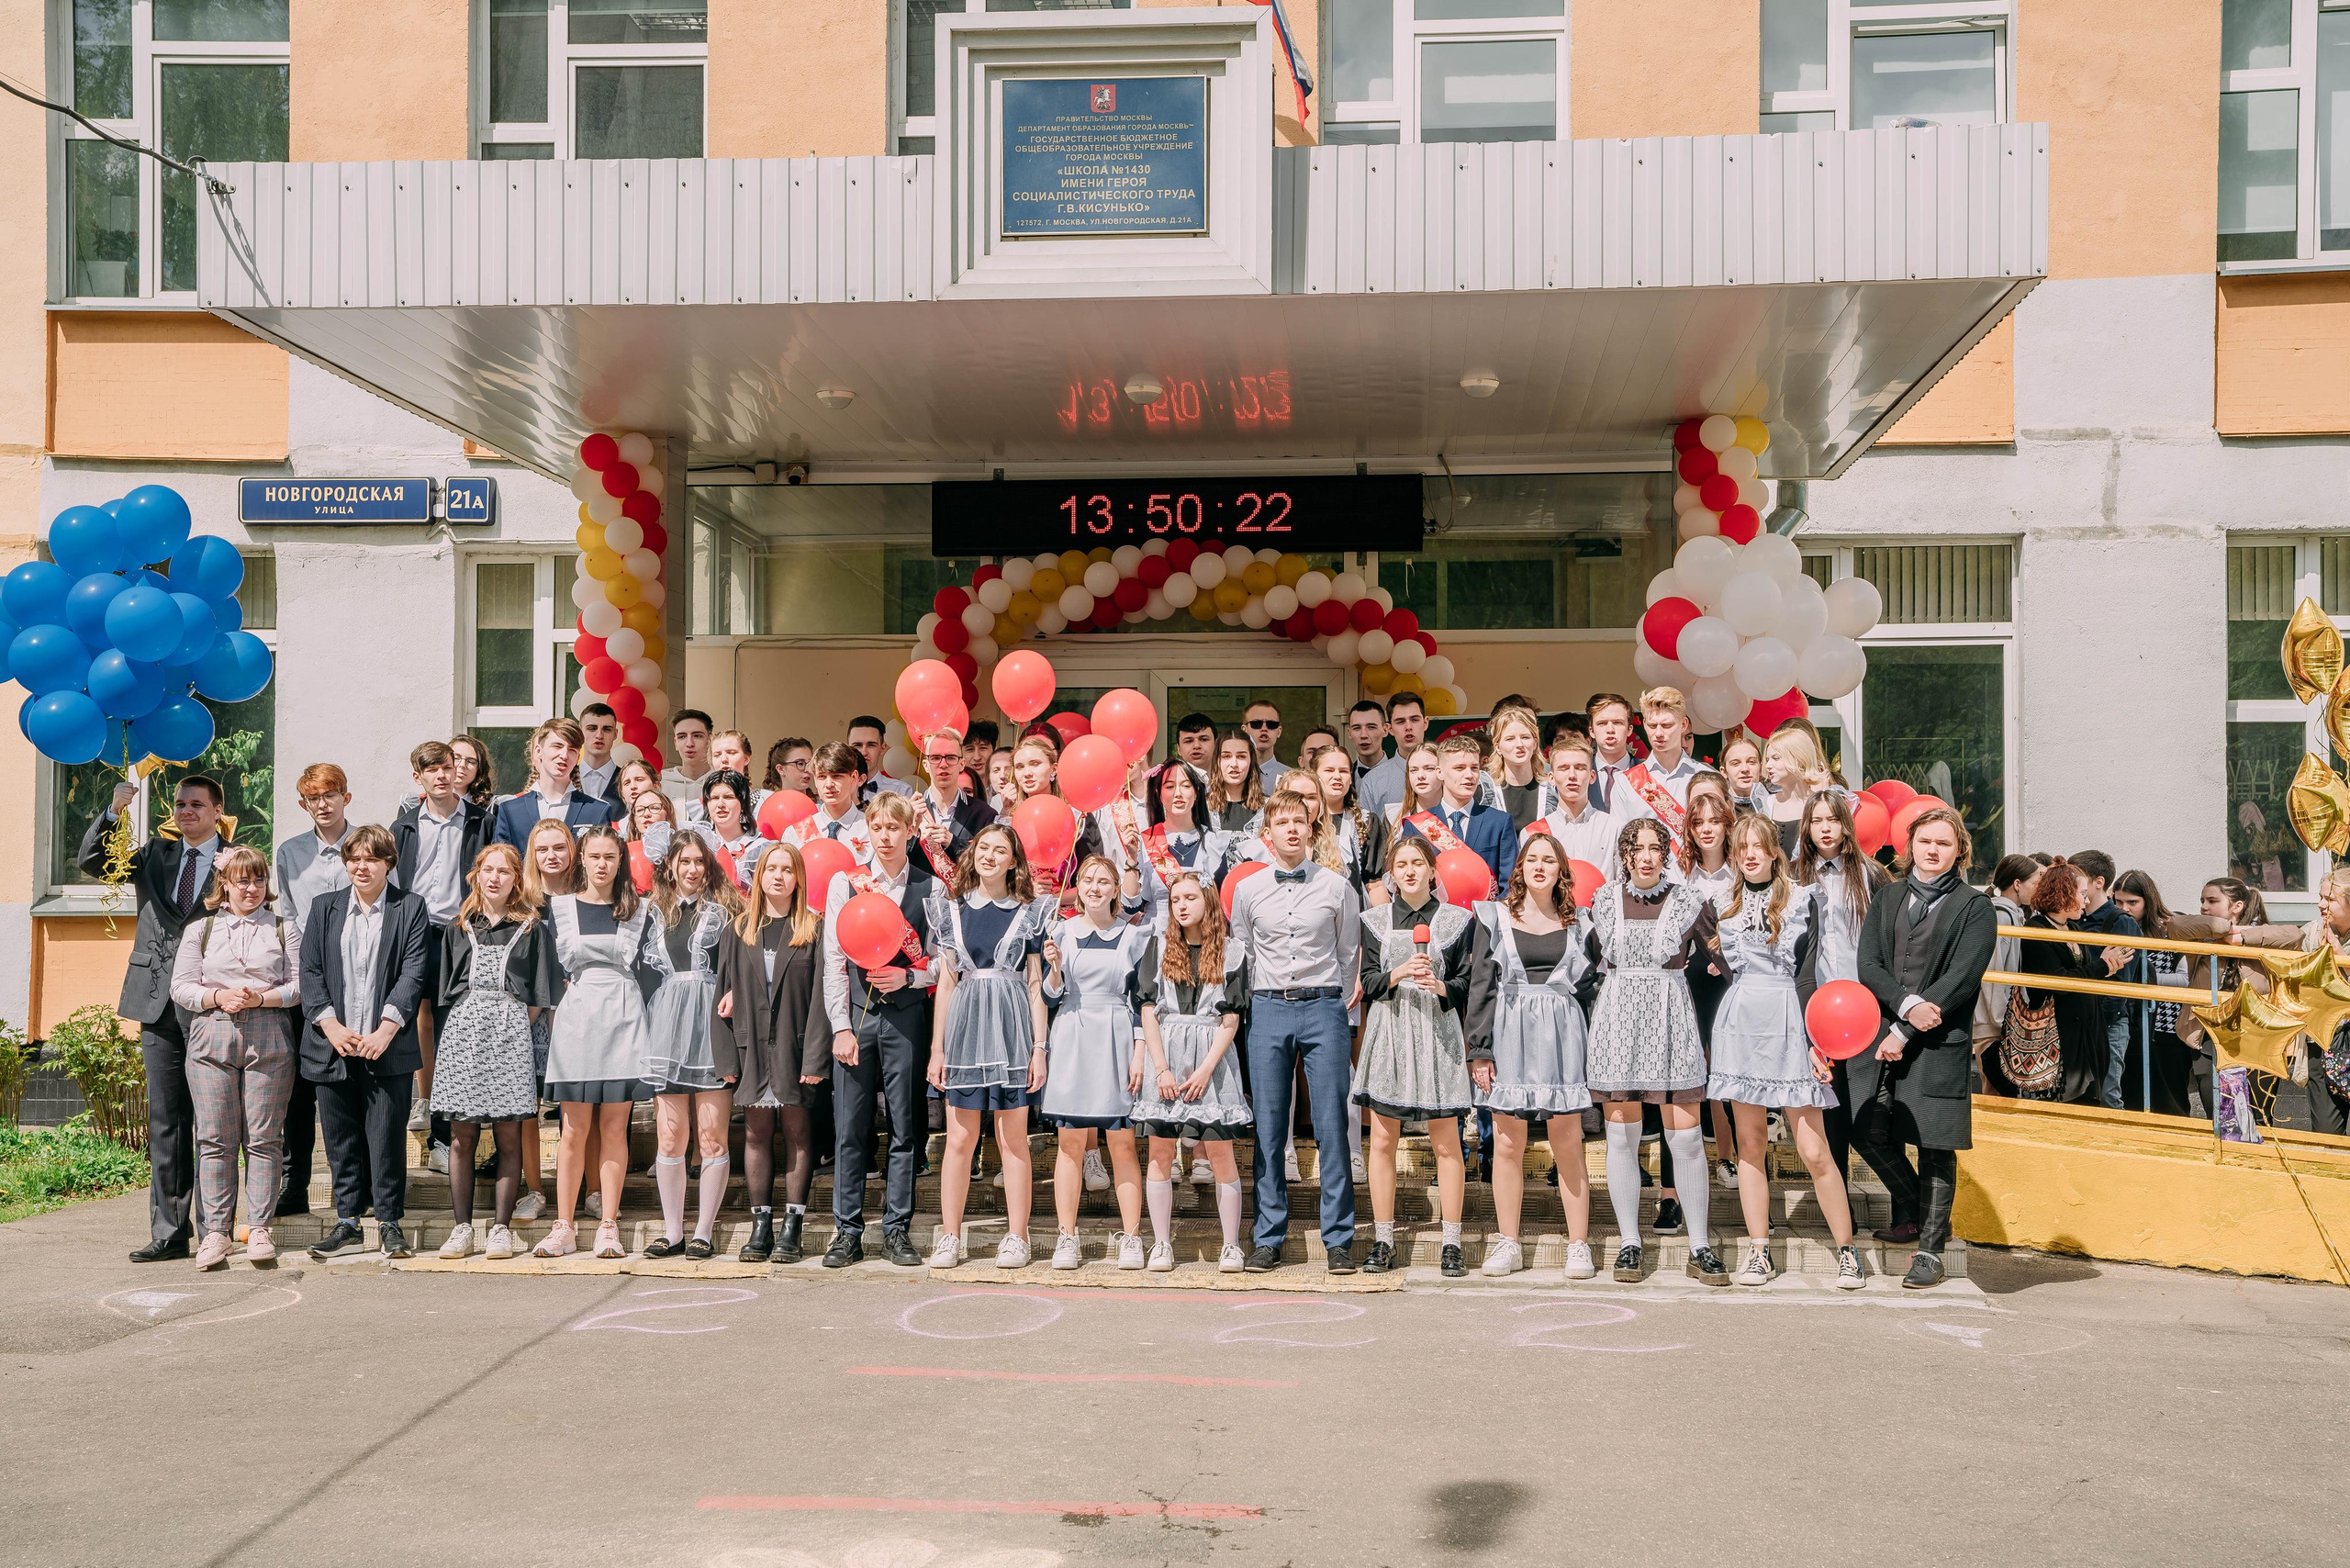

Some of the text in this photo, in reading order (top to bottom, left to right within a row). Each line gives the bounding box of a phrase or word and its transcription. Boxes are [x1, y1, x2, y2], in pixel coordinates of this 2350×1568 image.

[1017, 125, 1071, 133] ДЕПАРТАМЕНТ
[1030, 133, 1178, 143] ГОСУДАРСТВЕННОЕ БЮДЖЕТНОЕ
[1014, 141, 1193, 153] ОБЩЕОБРАЗОВАТЕЛЬНОЕ УЧРЕЖДЕНИЕ
[1065, 153, 1102, 162] ГОРОДА
[1057, 164, 1151, 175] «ШКОЛА №1430
[1060, 177, 1147, 188] ИМЕНИ ГЕРОЯ
[1013, 189, 1196, 202] СОЦИАЛИСТИЧЕСКОГО ТРУДА
[1058, 203, 1151, 214] Г.В.КИСУНЬКО»
[1053, 218, 1089, 227] МОСКВА,
[264, 487, 405, 504] НОВГОРОДСКАЯ
[450, 489, 485, 510] 21А
[314, 506, 354, 515] УЛИЦА
[1060, 493, 1292, 535] 13:50:22
